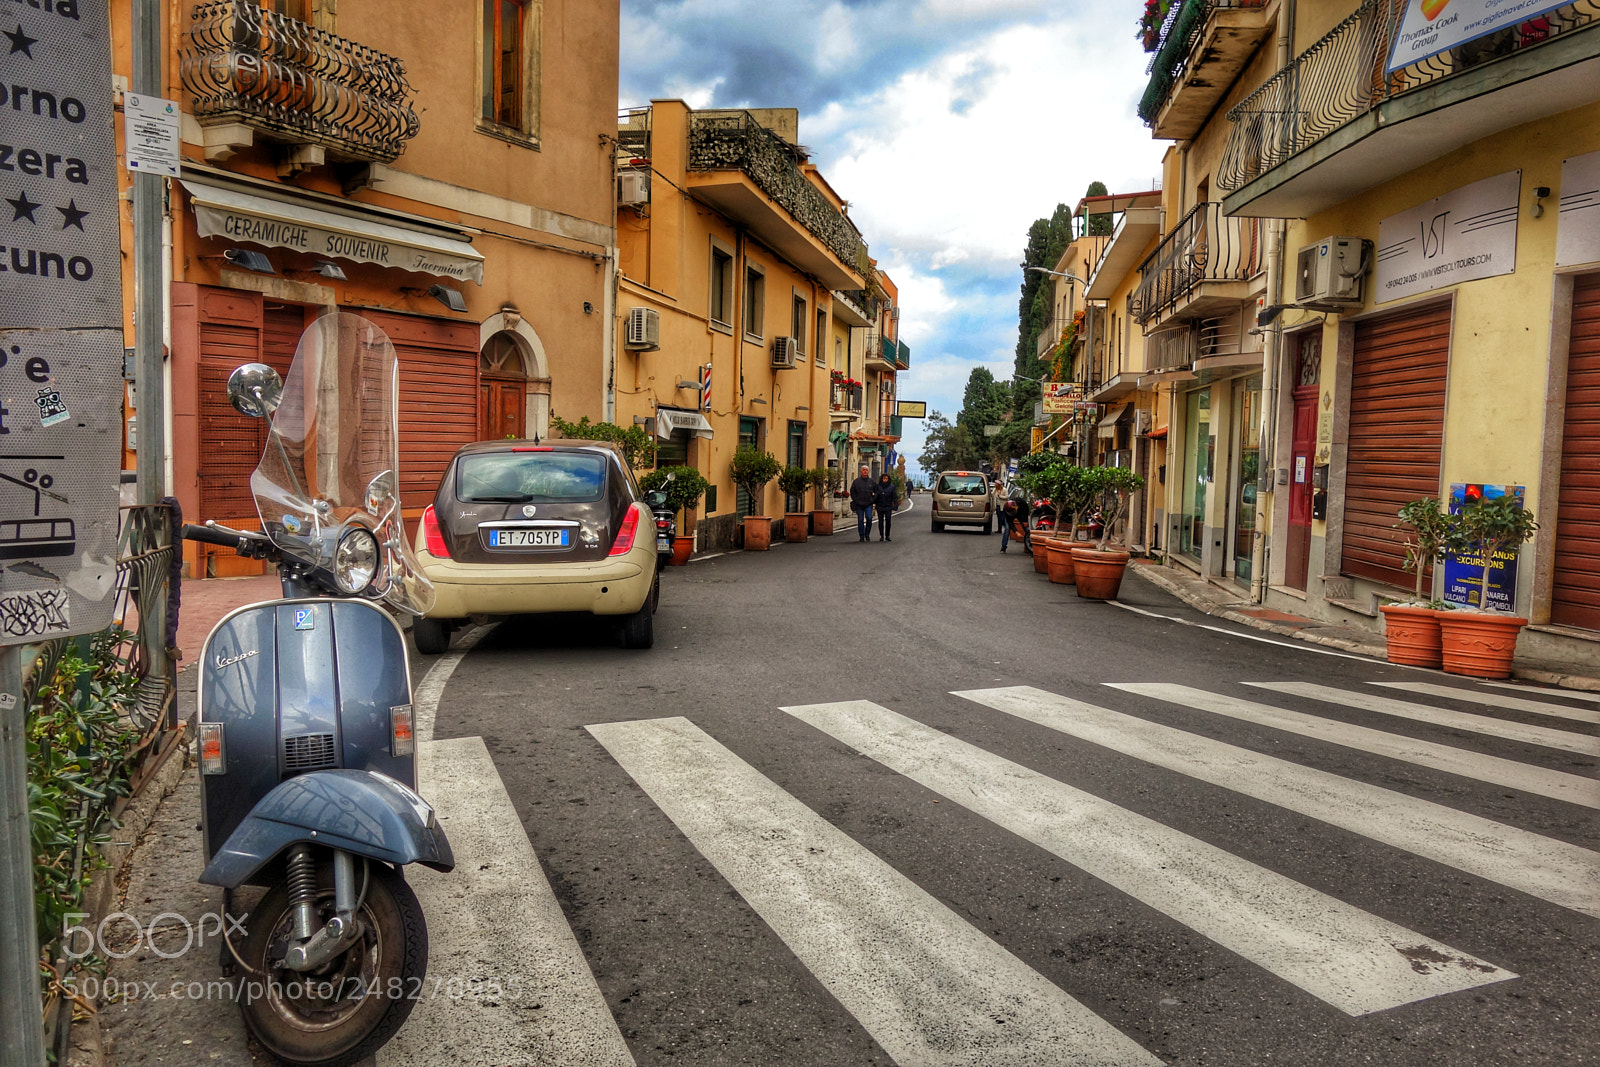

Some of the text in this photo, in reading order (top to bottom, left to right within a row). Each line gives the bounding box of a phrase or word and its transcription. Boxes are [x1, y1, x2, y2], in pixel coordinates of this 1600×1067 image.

[1400, 12, 1459, 44] Thomas Cook
[1412, 33, 1439, 50] Group
[225, 215, 464, 276] CERAMICHE SOUVENIR Taormina
[1456, 556, 1504, 569] EXCURSONS
[1451, 585, 1467, 594] LIPARI
[1486, 591, 1509, 601] ANAREA
[1444, 593, 1466, 603] VULCANO
[216, 649, 261, 670] Vespa
